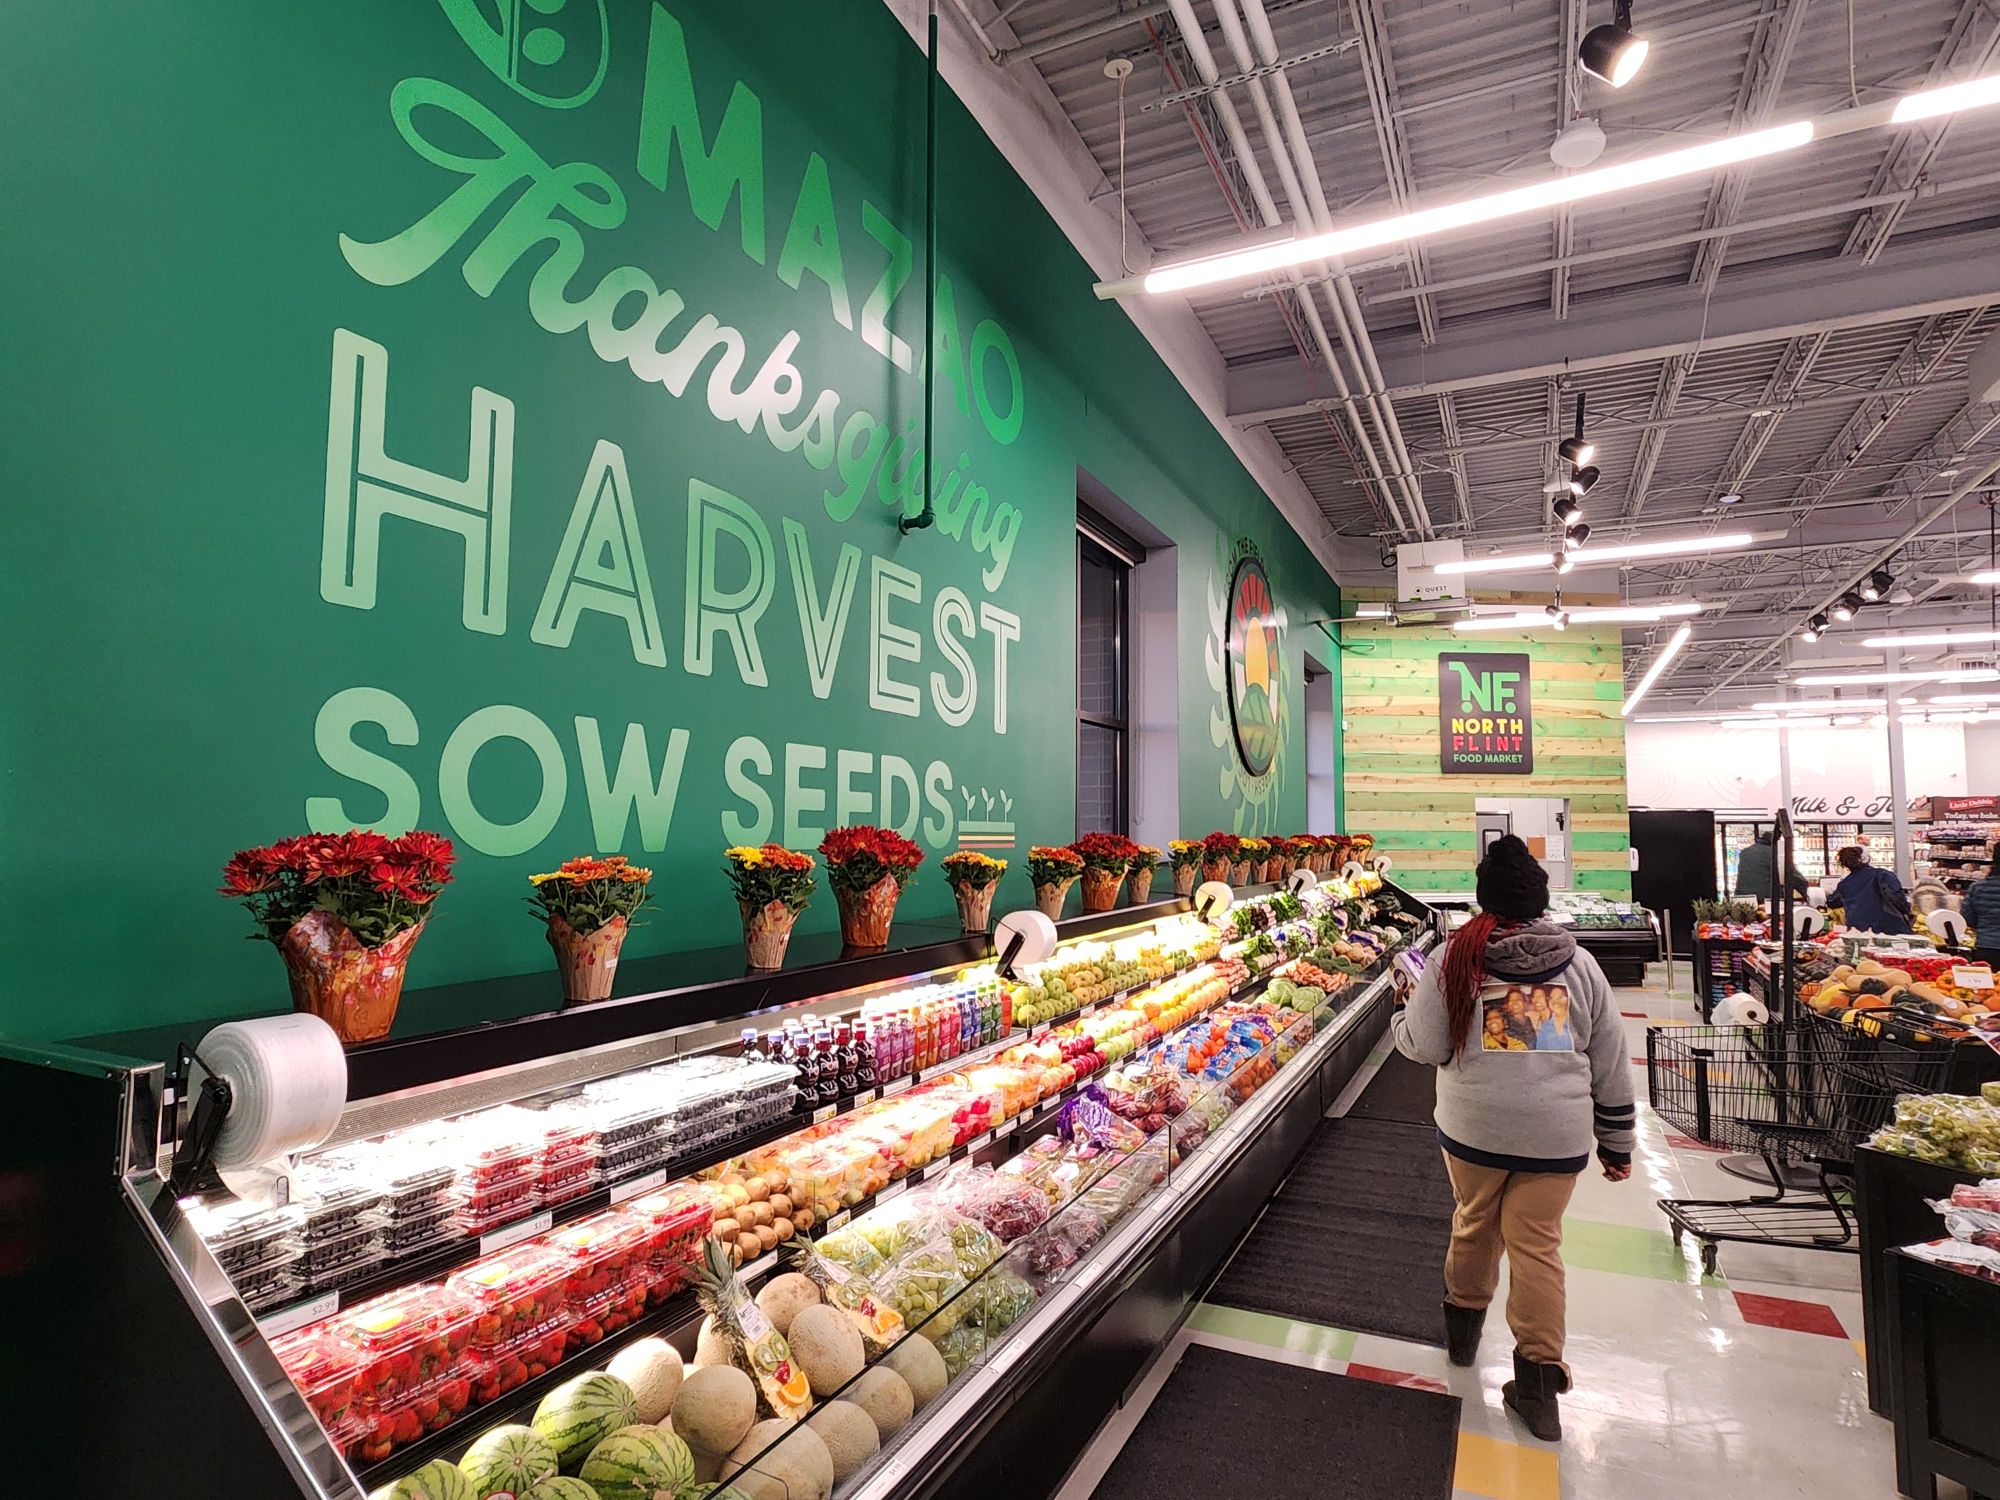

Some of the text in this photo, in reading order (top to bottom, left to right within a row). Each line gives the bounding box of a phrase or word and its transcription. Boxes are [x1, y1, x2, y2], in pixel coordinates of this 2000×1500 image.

[636, 1, 1024, 445] MAZAO
[338, 76, 1022, 592] Thanksgiving
[319, 327, 1021, 735] HARVEST
[1452, 718, 1523, 734] NORTH
[1453, 736, 1523, 751] FLINT
[1453, 754, 1523, 763] FOOD MARKET
[305, 687, 954, 857] SOW SEEDS
[1836, 796, 1860, 816] &
[312, 1300, 335, 1316] $2.99
